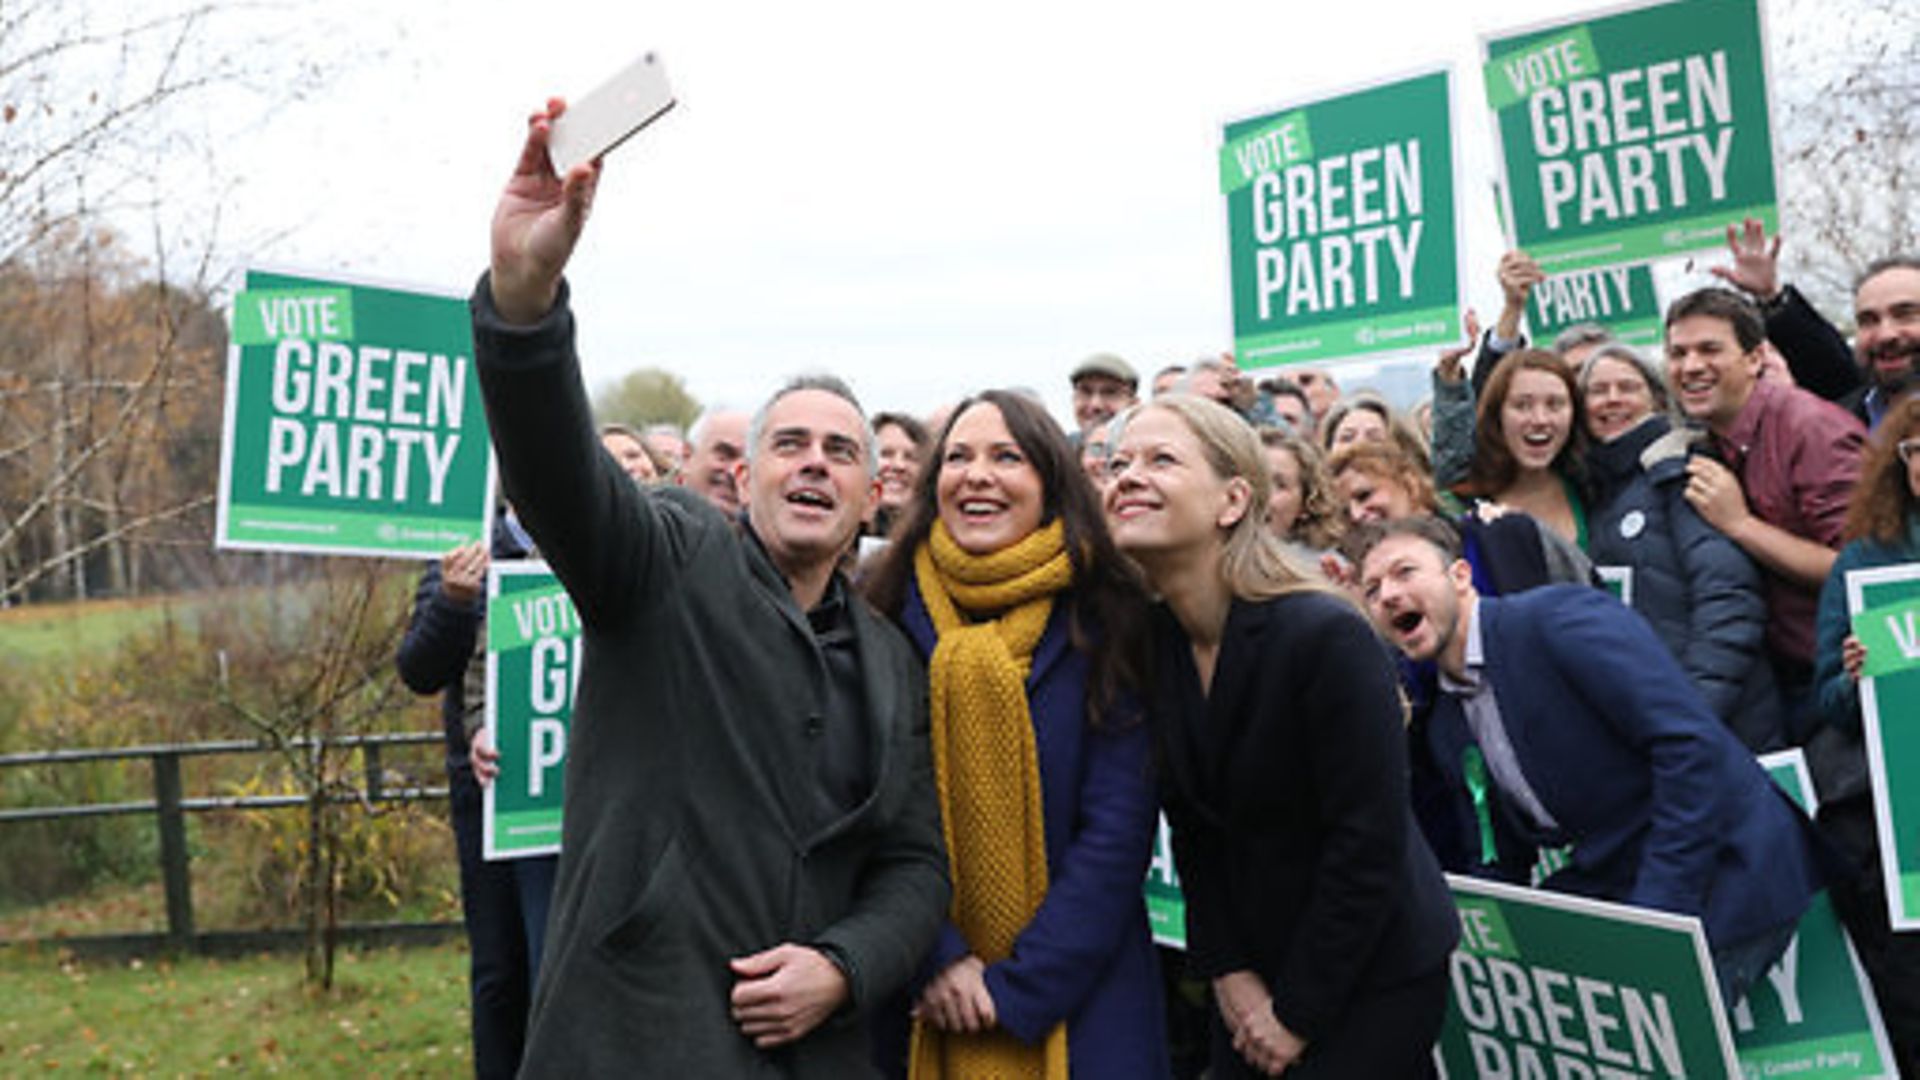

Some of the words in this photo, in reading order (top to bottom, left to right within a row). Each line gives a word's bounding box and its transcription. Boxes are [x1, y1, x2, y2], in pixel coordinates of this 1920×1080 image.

[1504, 38, 1584, 96] VOTE
[1529, 50, 1733, 158] GREEN
[1235, 121, 1300, 180] VOTE
[1253, 138, 1423, 245] GREEN
[1538, 127, 1735, 230] PARTY
[1256, 219, 1424, 321] PARTY
[1534, 265, 1632, 327] PARTY
[258, 295, 340, 338] VOTE
[272, 339, 467, 429] GREEN
[265, 416, 461, 505] PARTY
[513, 592, 582, 640] VOT
[1451, 950, 1690, 1080] GREEN
